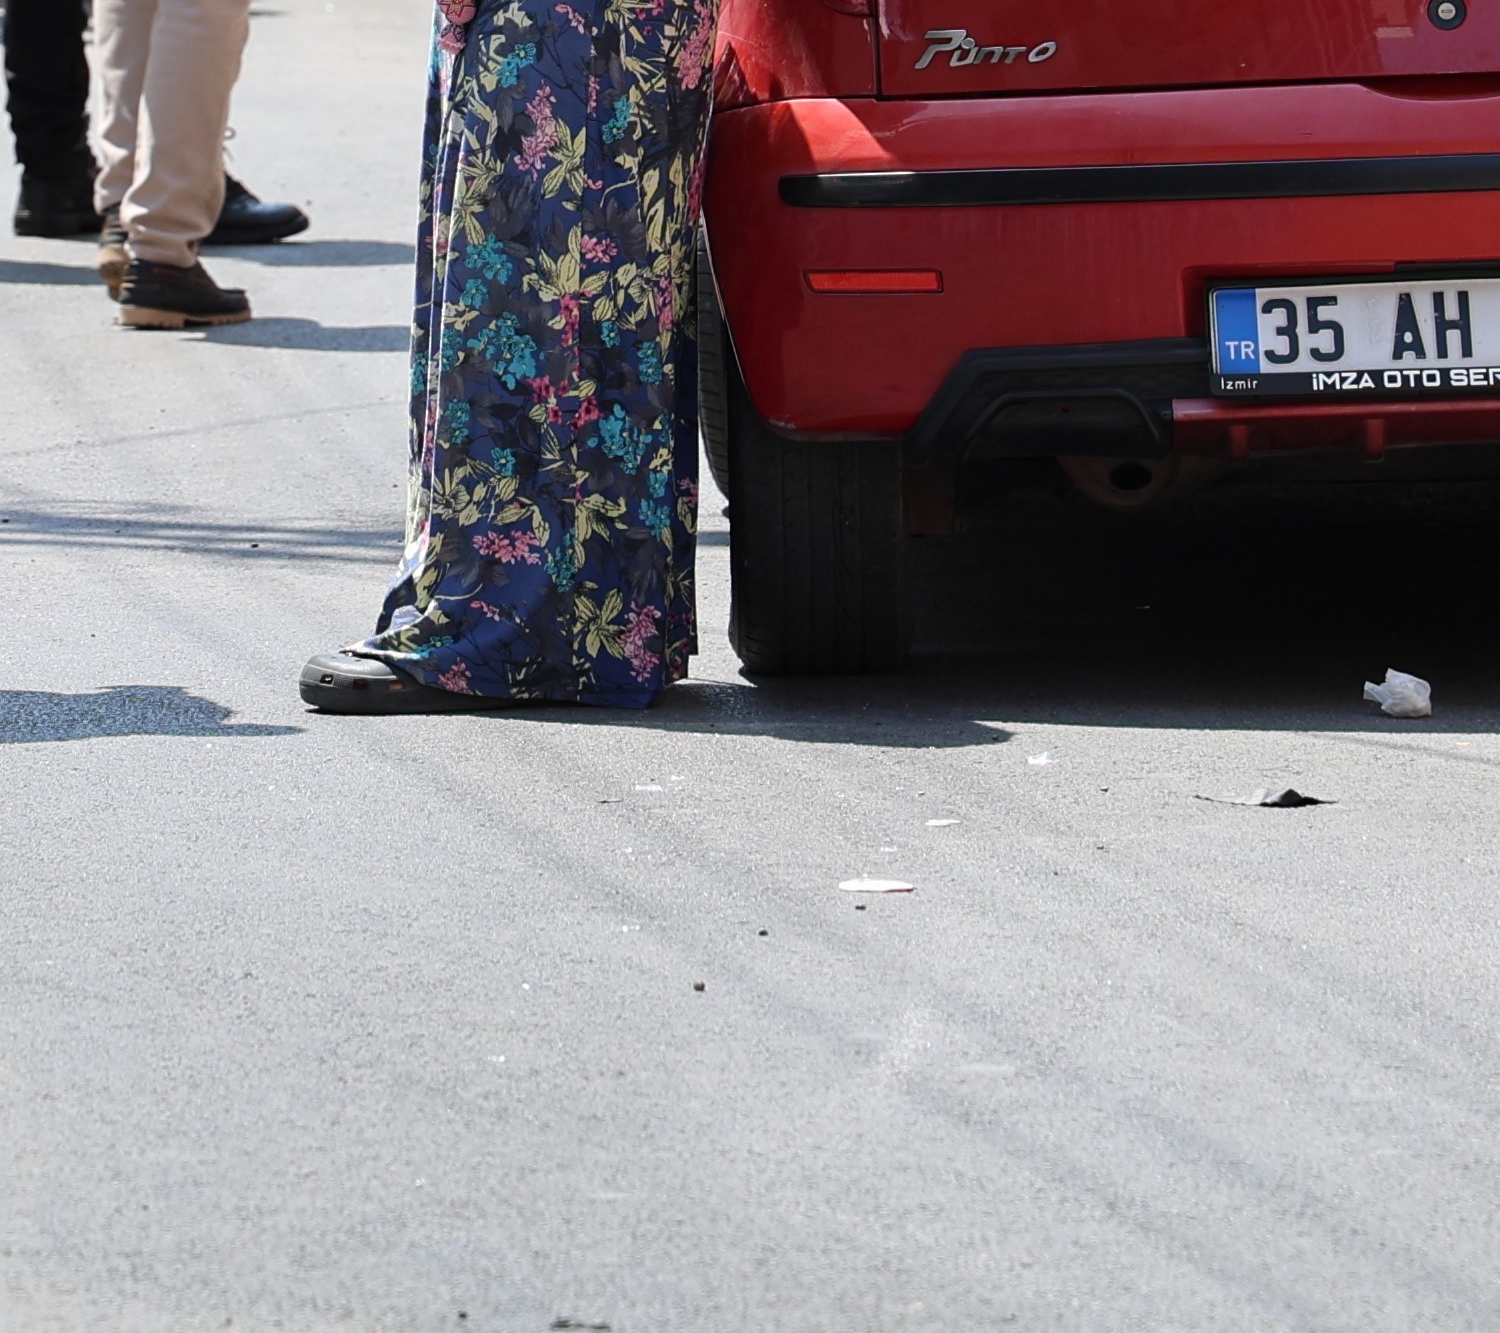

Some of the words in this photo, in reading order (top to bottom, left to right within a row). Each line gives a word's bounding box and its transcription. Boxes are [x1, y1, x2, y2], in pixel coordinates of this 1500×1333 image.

[1261, 296, 1345, 365] 35
[1392, 291, 1473, 361] AH
[1225, 341, 1255, 360] TR
[1383, 370, 1441, 389] OTO
